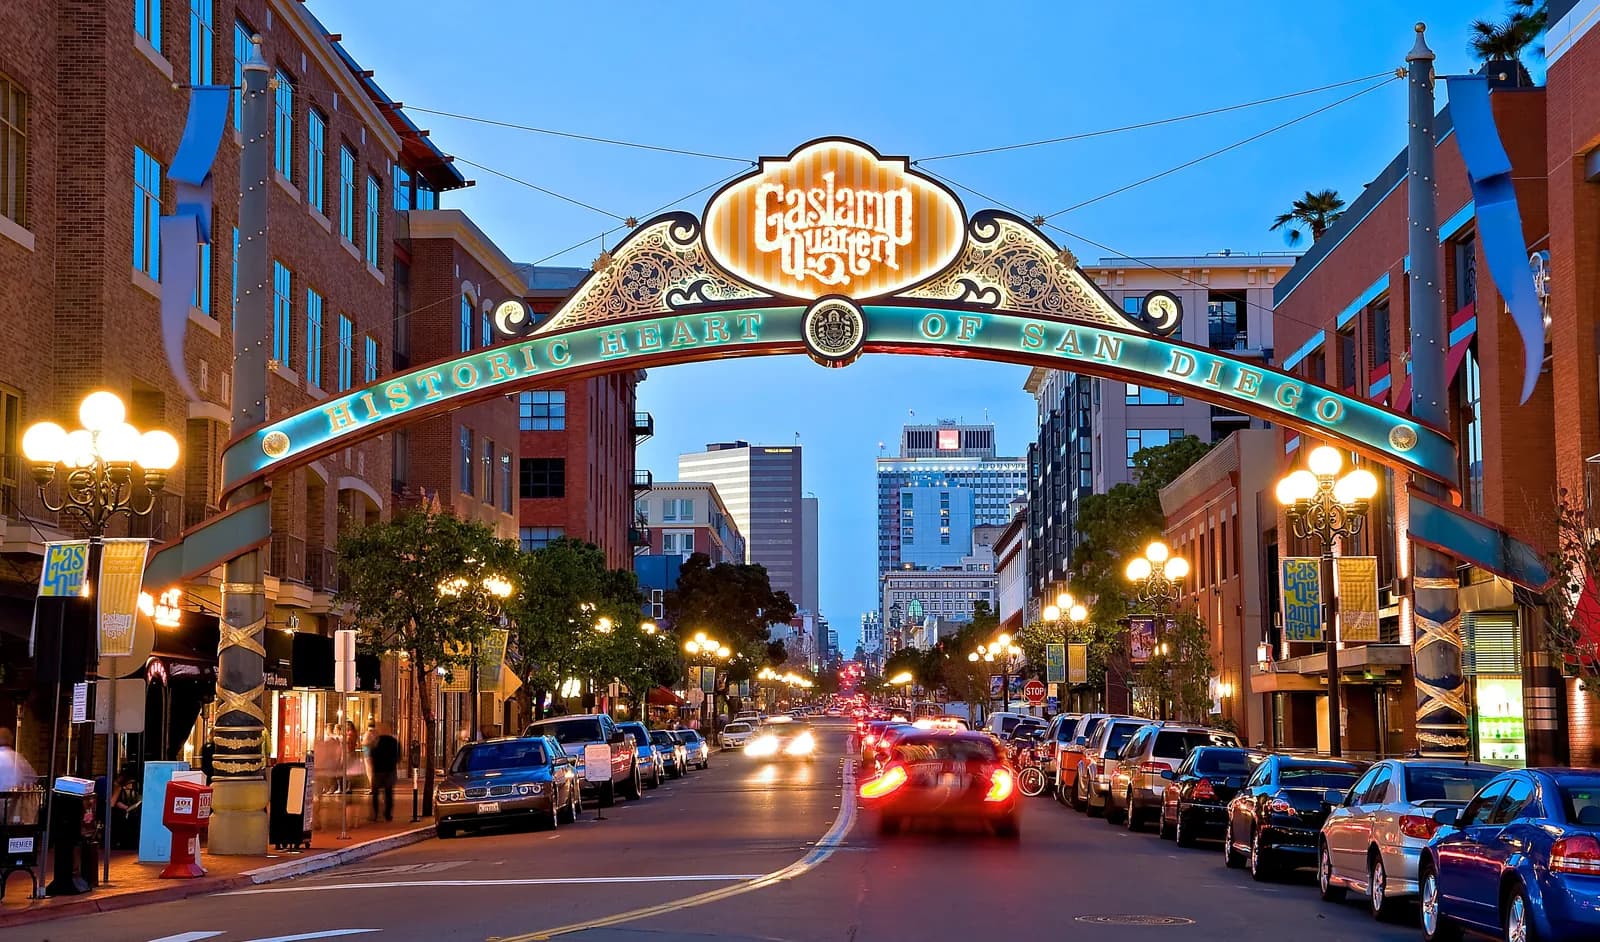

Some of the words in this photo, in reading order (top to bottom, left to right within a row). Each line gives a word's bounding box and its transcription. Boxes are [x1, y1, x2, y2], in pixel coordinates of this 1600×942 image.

[755, 171, 913, 253] Gaslamp
[781, 226, 900, 286] Quarter
[324, 338, 572, 433] HISTORIC
[600, 313, 761, 356] HEART
[921, 313, 982, 341] OF
[1022, 323, 1125, 361] SAN
[1166, 350, 1344, 423] DIEGO
[1026, 687, 1044, 696] STOP
